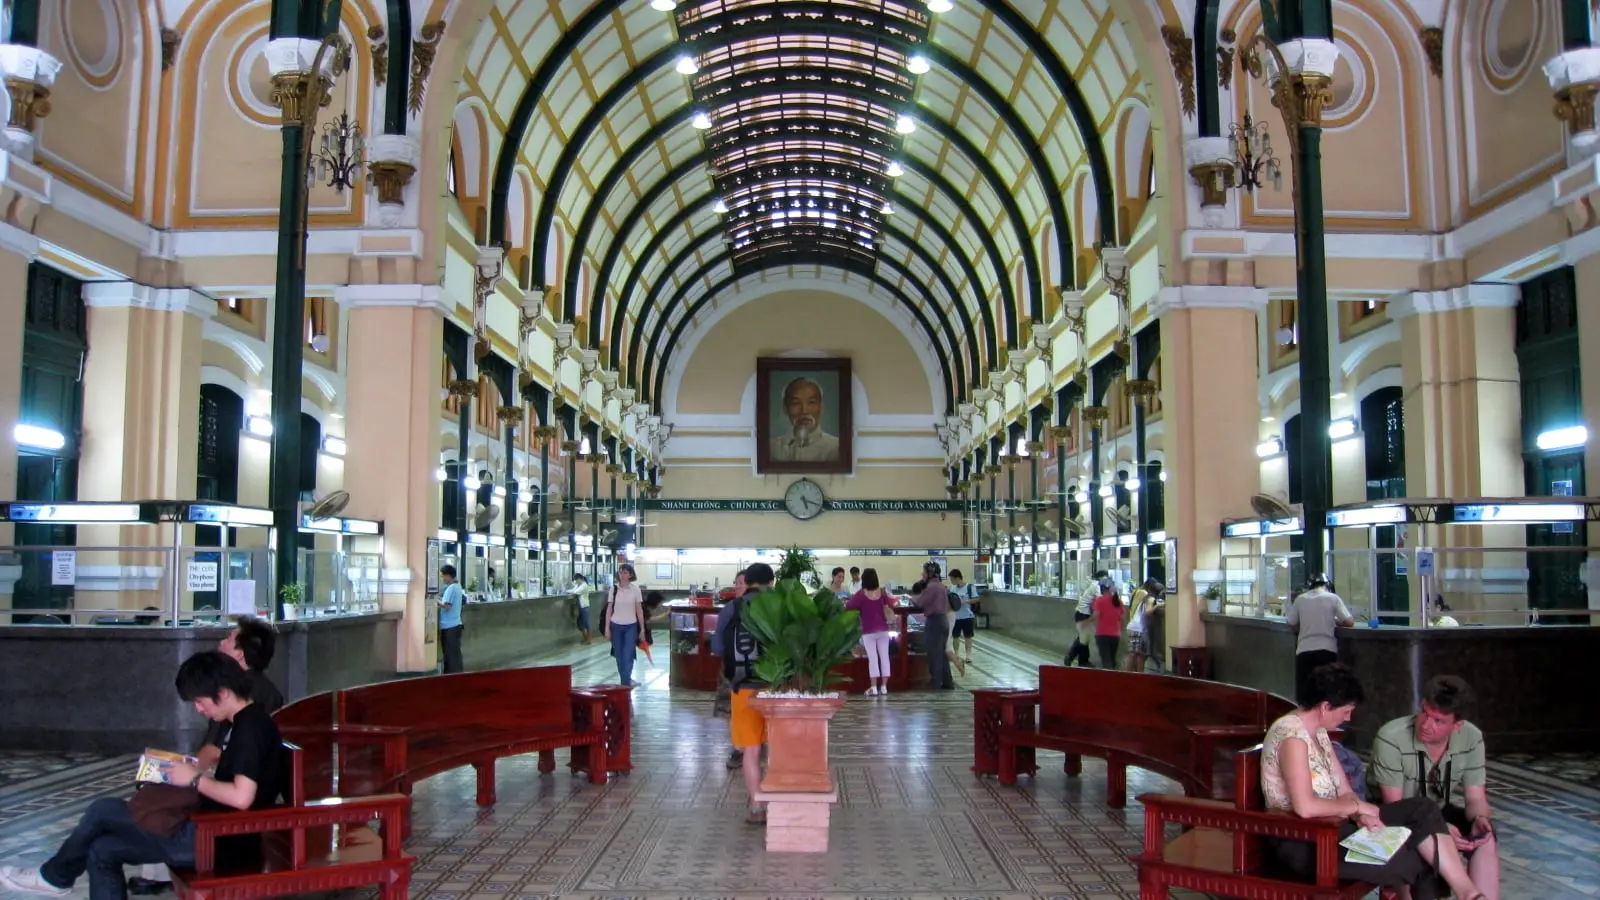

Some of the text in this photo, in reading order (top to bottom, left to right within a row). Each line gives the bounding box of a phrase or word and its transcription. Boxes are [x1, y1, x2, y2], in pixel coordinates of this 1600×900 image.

[661, 501, 690, 509] NHANH
[730, 500, 758, 509] CHÍNH
[927, 501, 948, 509] MINH
